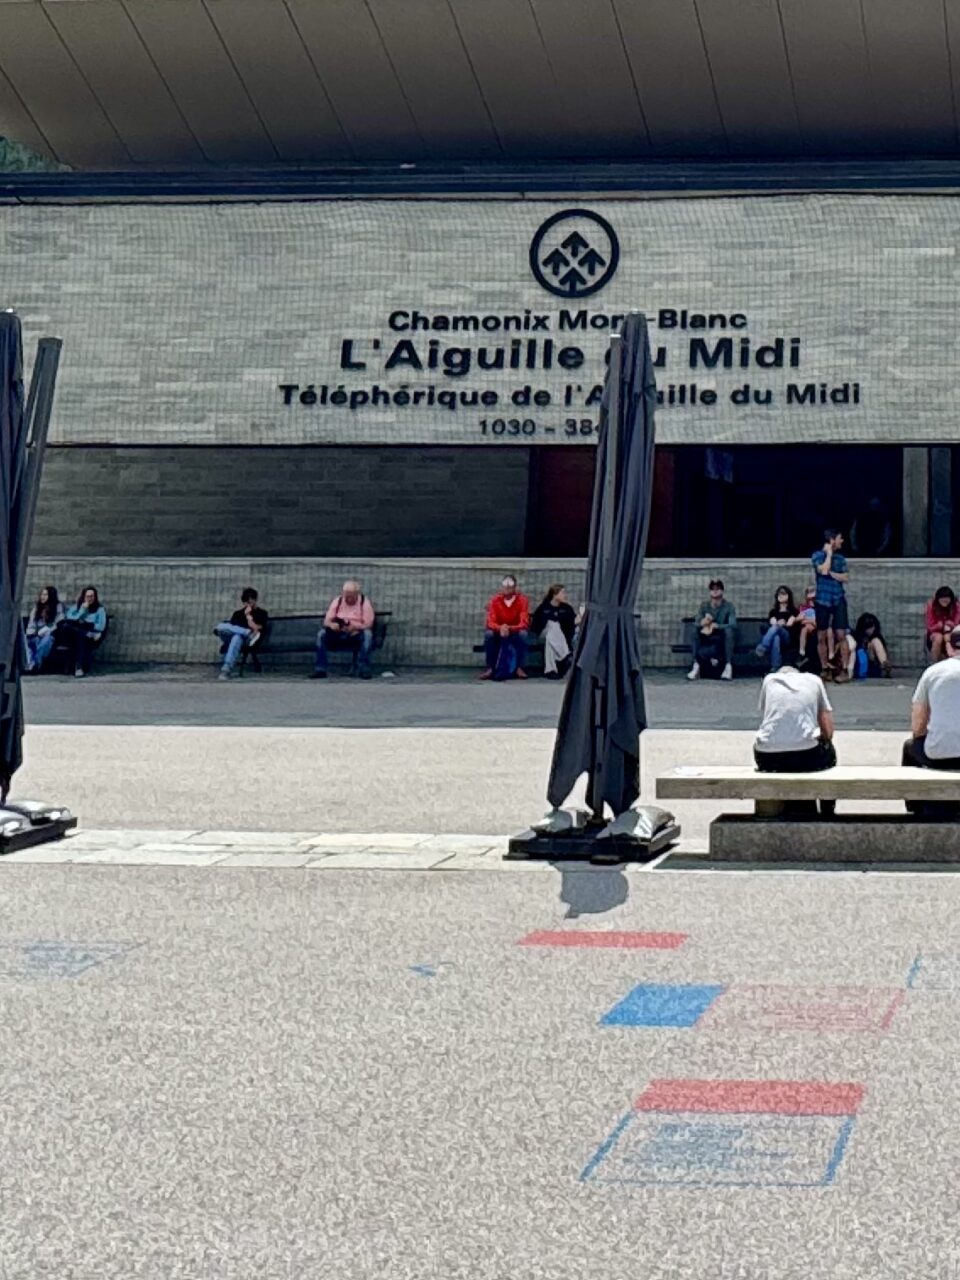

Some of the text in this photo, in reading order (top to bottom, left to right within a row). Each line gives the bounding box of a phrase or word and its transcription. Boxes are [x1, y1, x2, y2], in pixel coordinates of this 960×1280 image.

[388, 308, 748, 332] Chamonix Mon-Blanc
[340, 337, 801, 377] L'Aiguille u Midi
[278, 382, 860, 410] Téléphérique de l'Aille du Midi
[479, 418, 536, 436] 1030
[564, 417, 600, 436] 38
